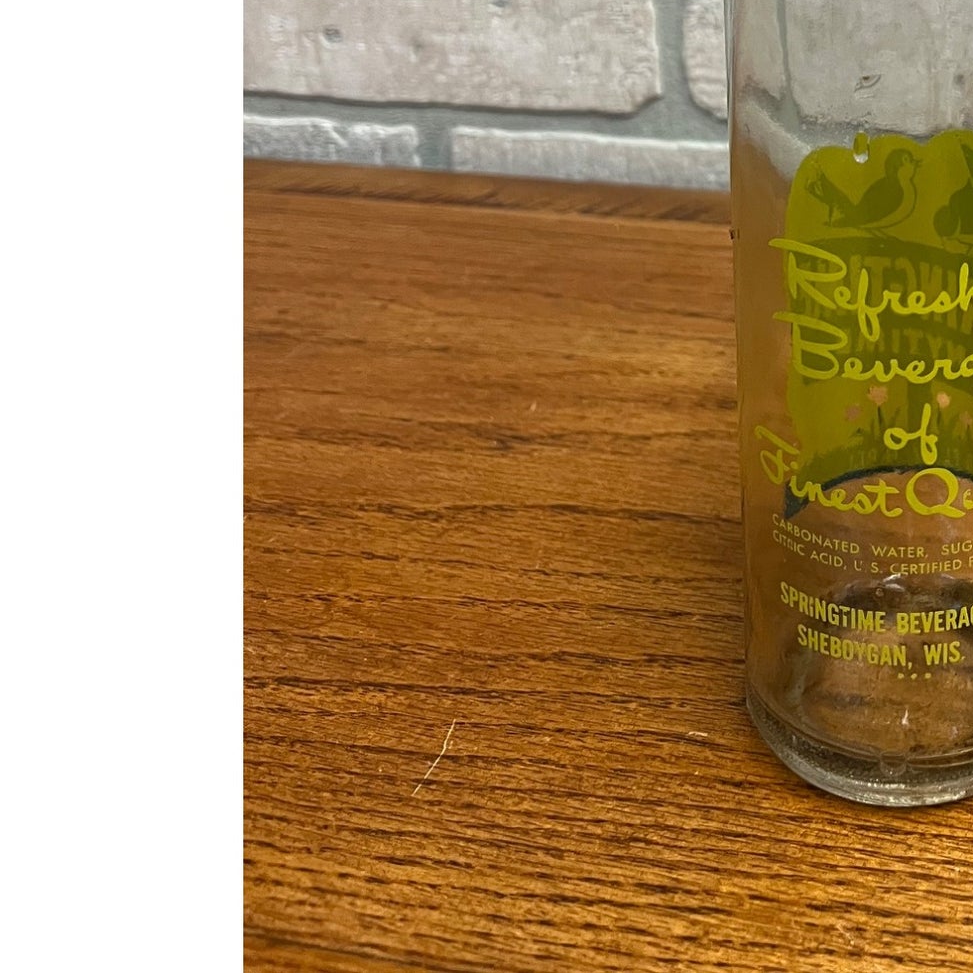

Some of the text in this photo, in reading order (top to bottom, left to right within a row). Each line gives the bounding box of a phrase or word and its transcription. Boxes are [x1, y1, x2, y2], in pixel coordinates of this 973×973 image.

[884, 403, 939, 465] of
[755, 425, 903, 517] Finest
[772, 513, 860, 554] CARBONATED
[872, 545, 928, 559] WATER,
[772, 530, 805, 555] CITRIC
[810, 550, 847, 570] ACID,
[889, 559, 962, 575] CERTIFIED
[780, 581, 886, 633] SPRINGTIME
[797, 624, 913, 671] SHEBOYGAN,
[923, 641, 966, 666] WIS.
